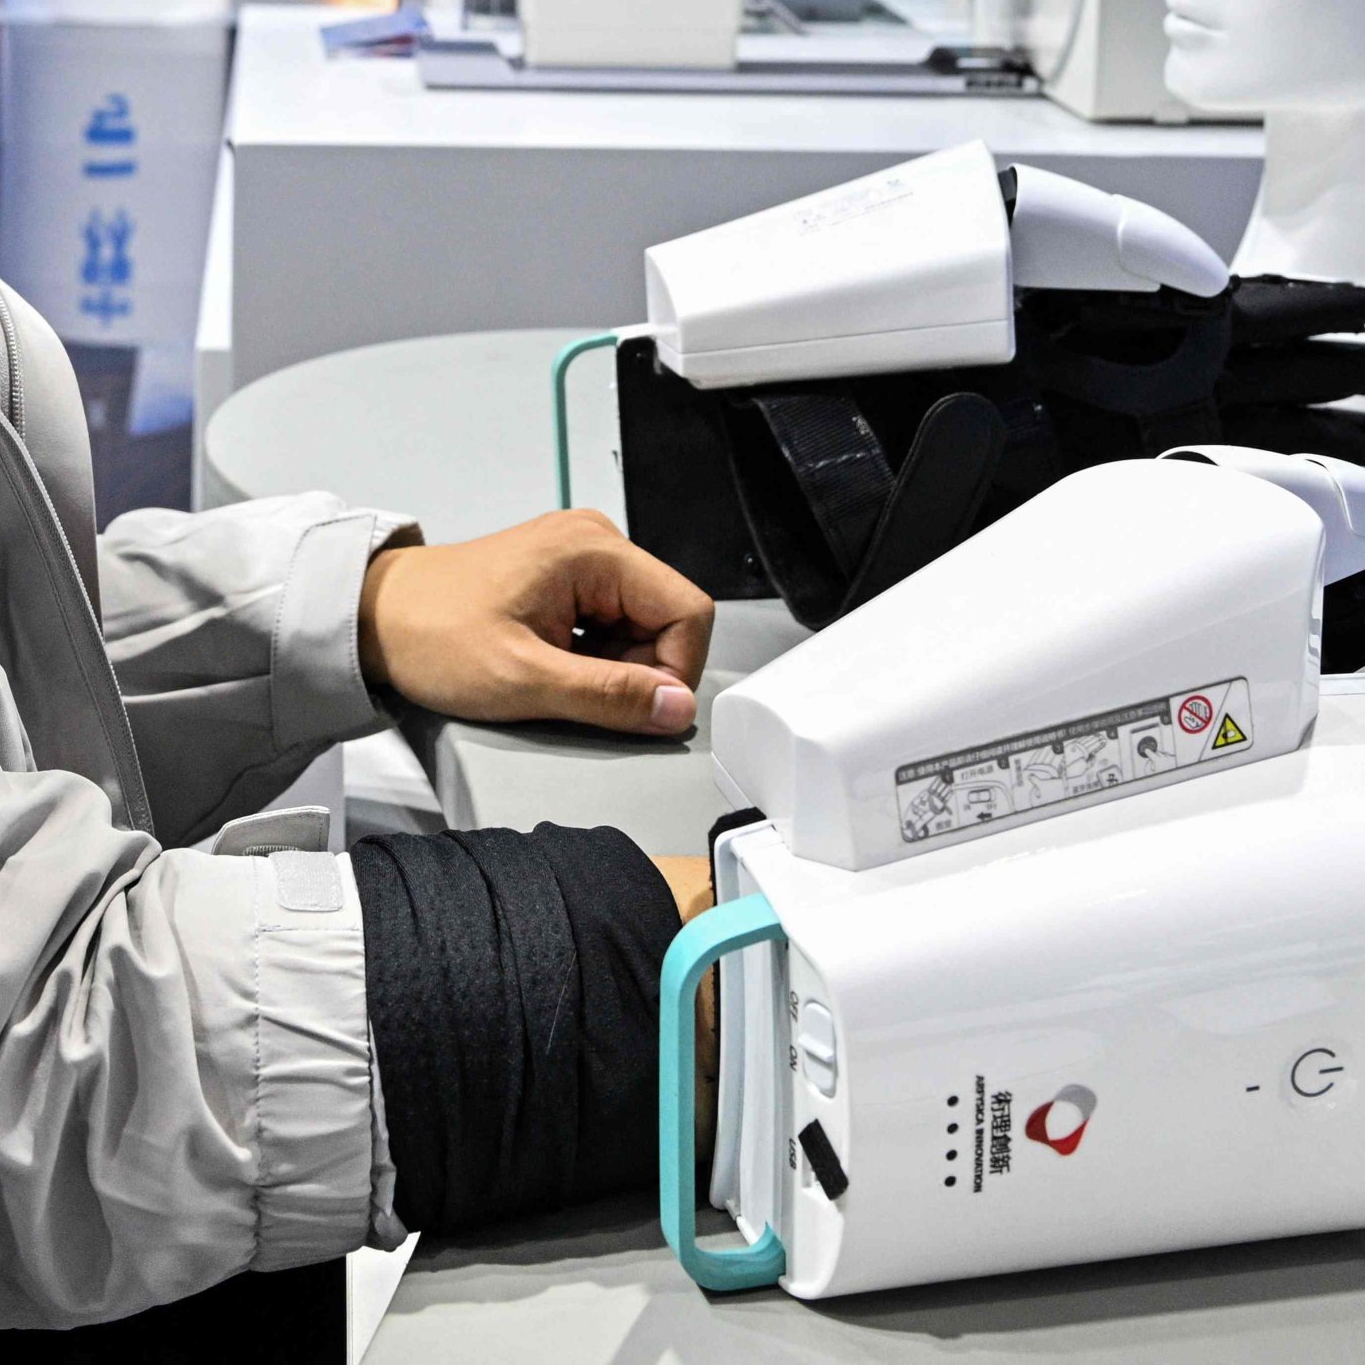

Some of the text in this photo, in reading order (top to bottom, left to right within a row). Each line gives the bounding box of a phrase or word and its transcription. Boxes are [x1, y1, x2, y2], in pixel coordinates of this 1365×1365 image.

[789, 990, 800, 1023] OFF
[789, 1045, 799, 1072] ON
[788, 1137, 798, 1171] USB
